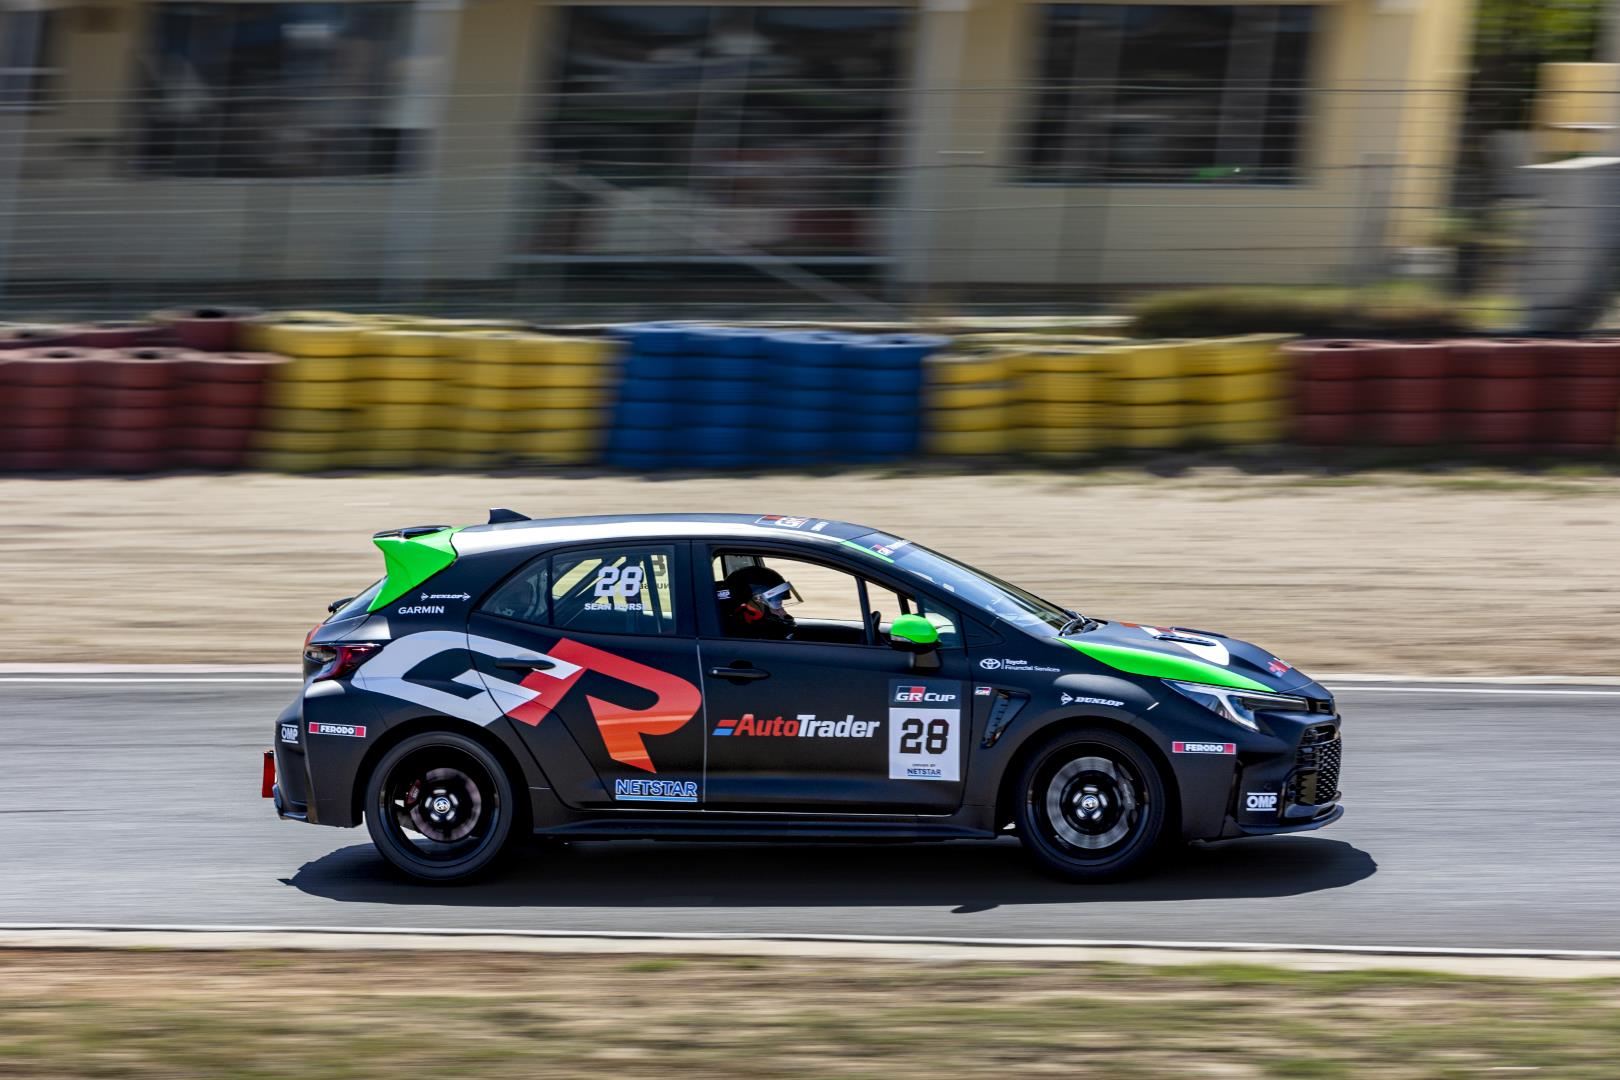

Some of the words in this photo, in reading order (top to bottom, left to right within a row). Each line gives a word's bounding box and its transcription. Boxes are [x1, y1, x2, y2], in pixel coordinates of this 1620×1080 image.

[594, 566, 643, 597] 28
[398, 605, 445, 615] GARMIN
[350, 630, 704, 774] GR
[895, 692, 922, 701] GR
[1074, 696, 1125, 707] DUNLOP
[320, 725, 355, 735] FERODO
[733, 713, 881, 738] AutoTrader
[281, 726, 298, 741] OMP
[899, 718, 950, 755] 28
[1185, 743, 1224, 752] FERODO
[615, 778, 698, 797] NETSTAR
[1246, 795, 1278, 808] OMP
